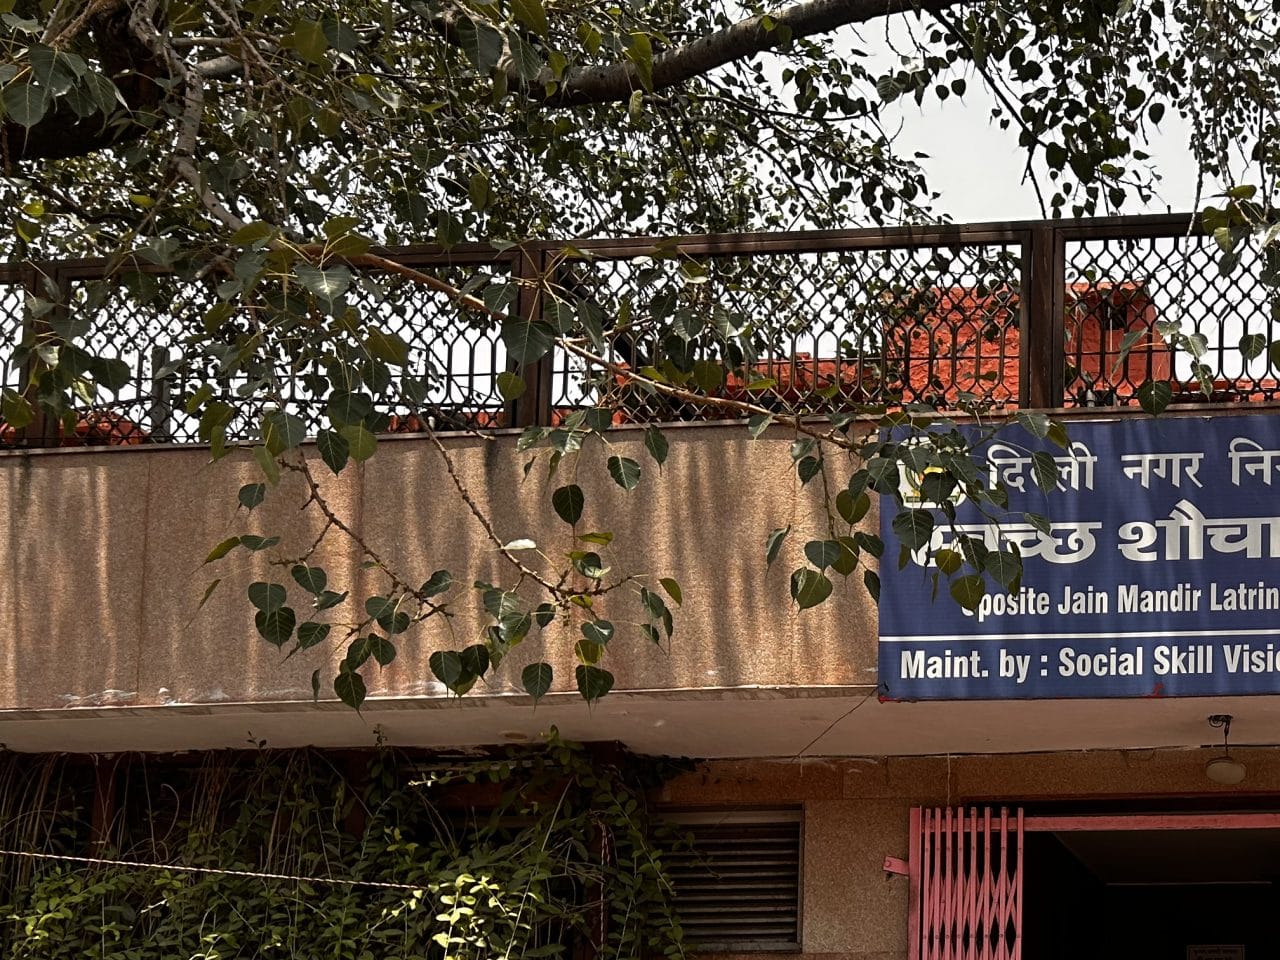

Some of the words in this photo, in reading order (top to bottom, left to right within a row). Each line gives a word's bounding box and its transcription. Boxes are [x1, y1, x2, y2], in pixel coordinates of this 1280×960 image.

[1121, 452, 1204, 489] नगर
[1057, 585, 1109, 615] Jain
[1117, 583, 1202, 613] Mandir
[900, 647, 989, 679] Maint.
[999, 648, 1031, 684] by
[1040, 654, 1048, 677] :
[1058, 646, 1144, 678] Social
[1153, 645, 1213, 676] Skill
